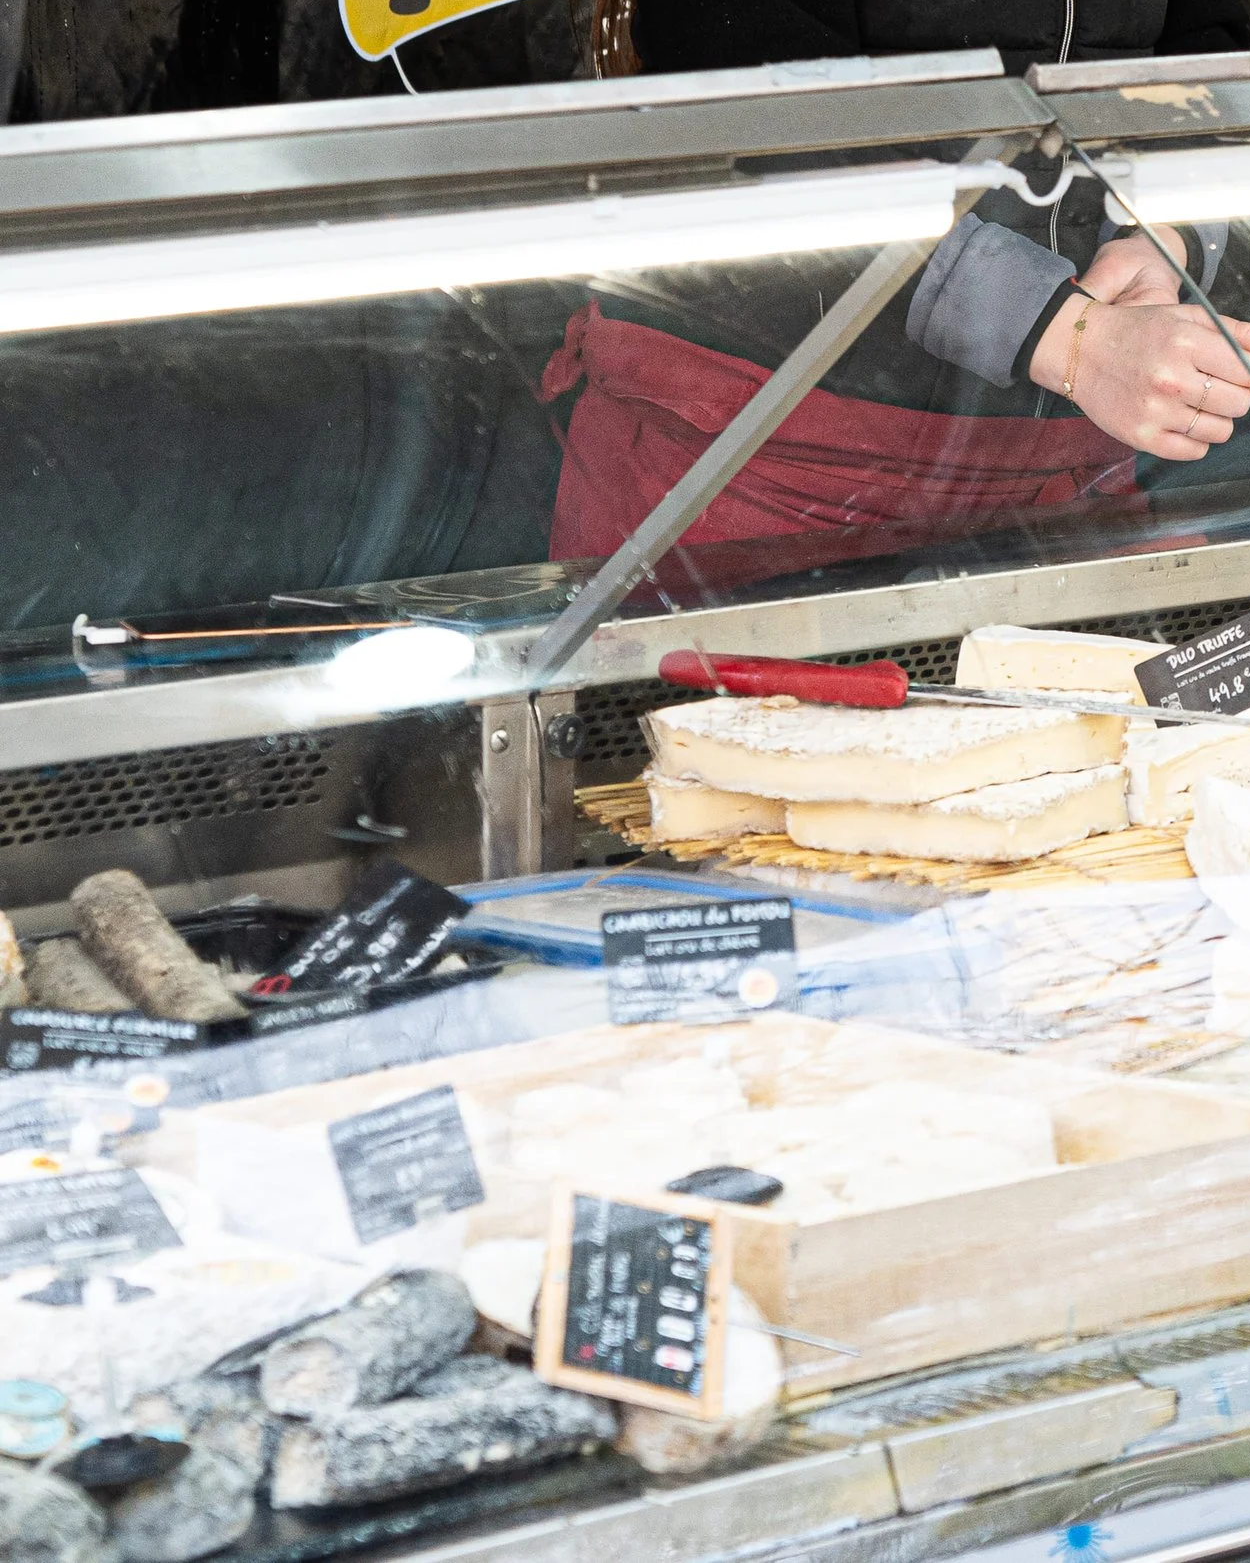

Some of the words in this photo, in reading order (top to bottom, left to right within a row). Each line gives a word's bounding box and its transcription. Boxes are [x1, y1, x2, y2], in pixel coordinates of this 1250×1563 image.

[1165, 646, 1195, 670] DUO
[1196, 623, 1246, 655] TRUFFE
[1176, 679, 1189, 688] Lait
[1205, 664, 1222, 675] vache
